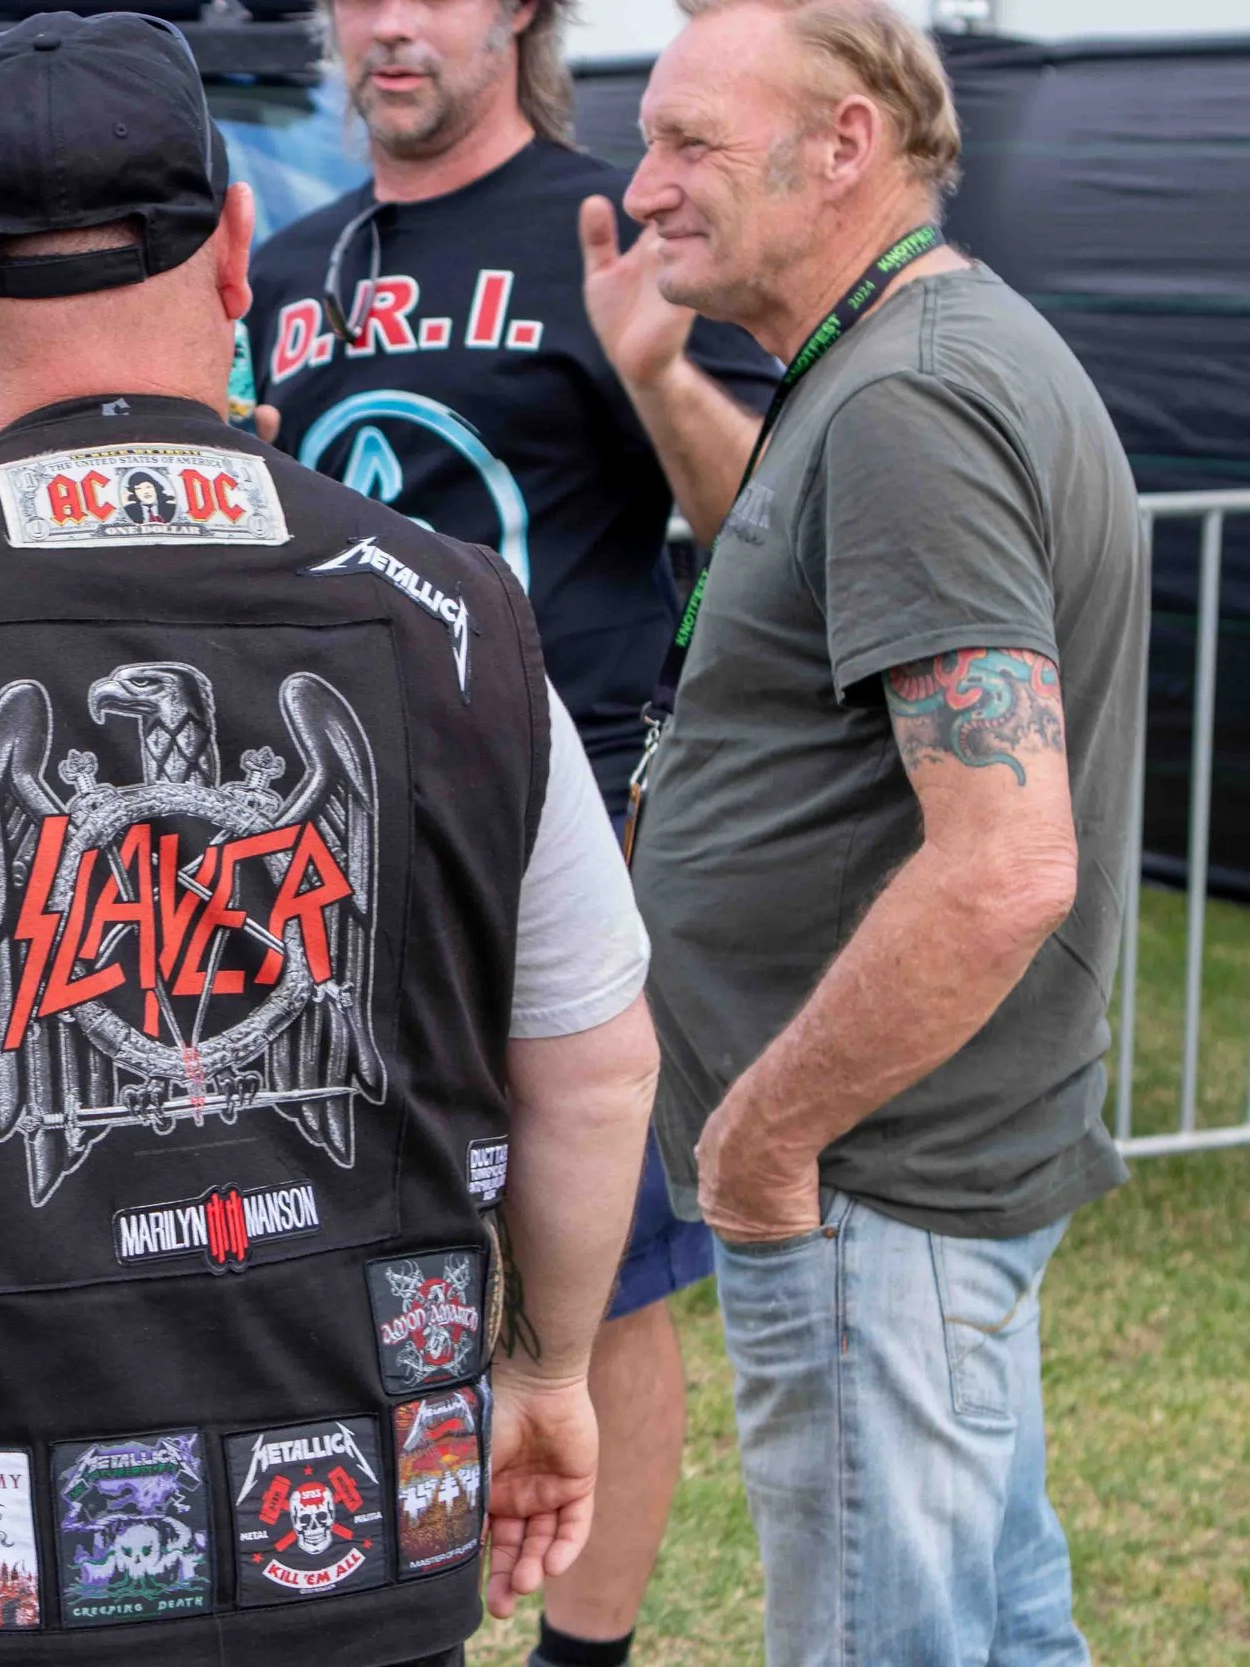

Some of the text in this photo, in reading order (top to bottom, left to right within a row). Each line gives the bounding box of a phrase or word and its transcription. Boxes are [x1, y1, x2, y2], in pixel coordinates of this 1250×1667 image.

[76, 458, 118, 469] UNITED
[119, 456, 157, 465] STATES
[161, 456, 174, 465] OF
[175, 456, 223, 470] AMERICA
[105, 525, 200, 536] ONE DOLLAR
[309, 536, 469, 692] METALLICA
[2, 815, 354, 1052] SLAYER
[119, 1185, 320, 1257] MARILYN MANSON
[62, 1439, 201, 1496] METALLICA
[235, 1421, 380, 1507] METALLICA
[266, 1553, 363, 1586] KILL 'EM ALL
[72, 1603, 143, 1618] CREEPING
[158, 1596, 204, 1612] DEATH
